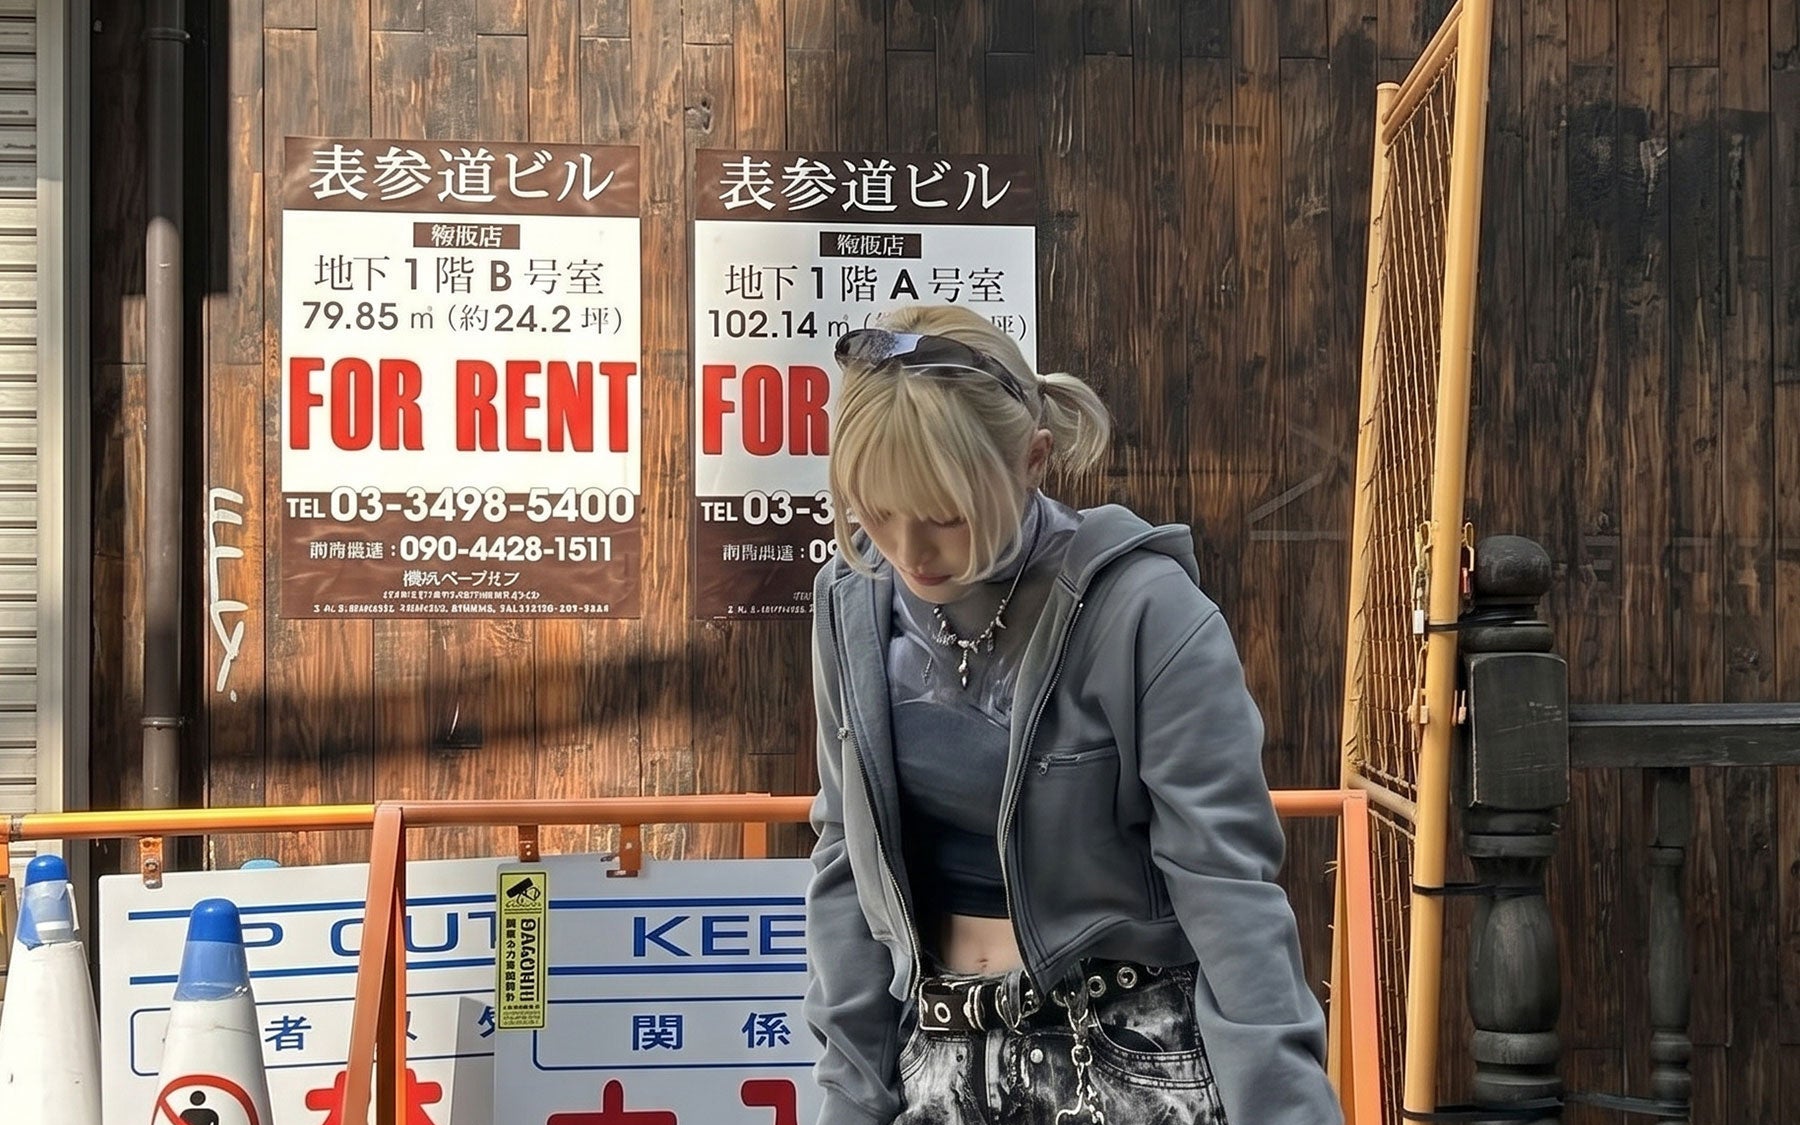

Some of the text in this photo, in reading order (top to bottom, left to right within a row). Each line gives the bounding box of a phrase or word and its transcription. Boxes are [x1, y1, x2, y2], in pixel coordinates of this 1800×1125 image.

[308, 144, 614, 202] 表参道ビル
[719, 156, 1011, 213] 表参道ビル
[290, 357, 637, 452] FOR RENT
[702, 365, 830, 456] FOR
[287, 486, 634, 523] TEL 03-3498-5400
[701, 502, 738, 521] TEL
[633, 914, 807, 958] KEE
